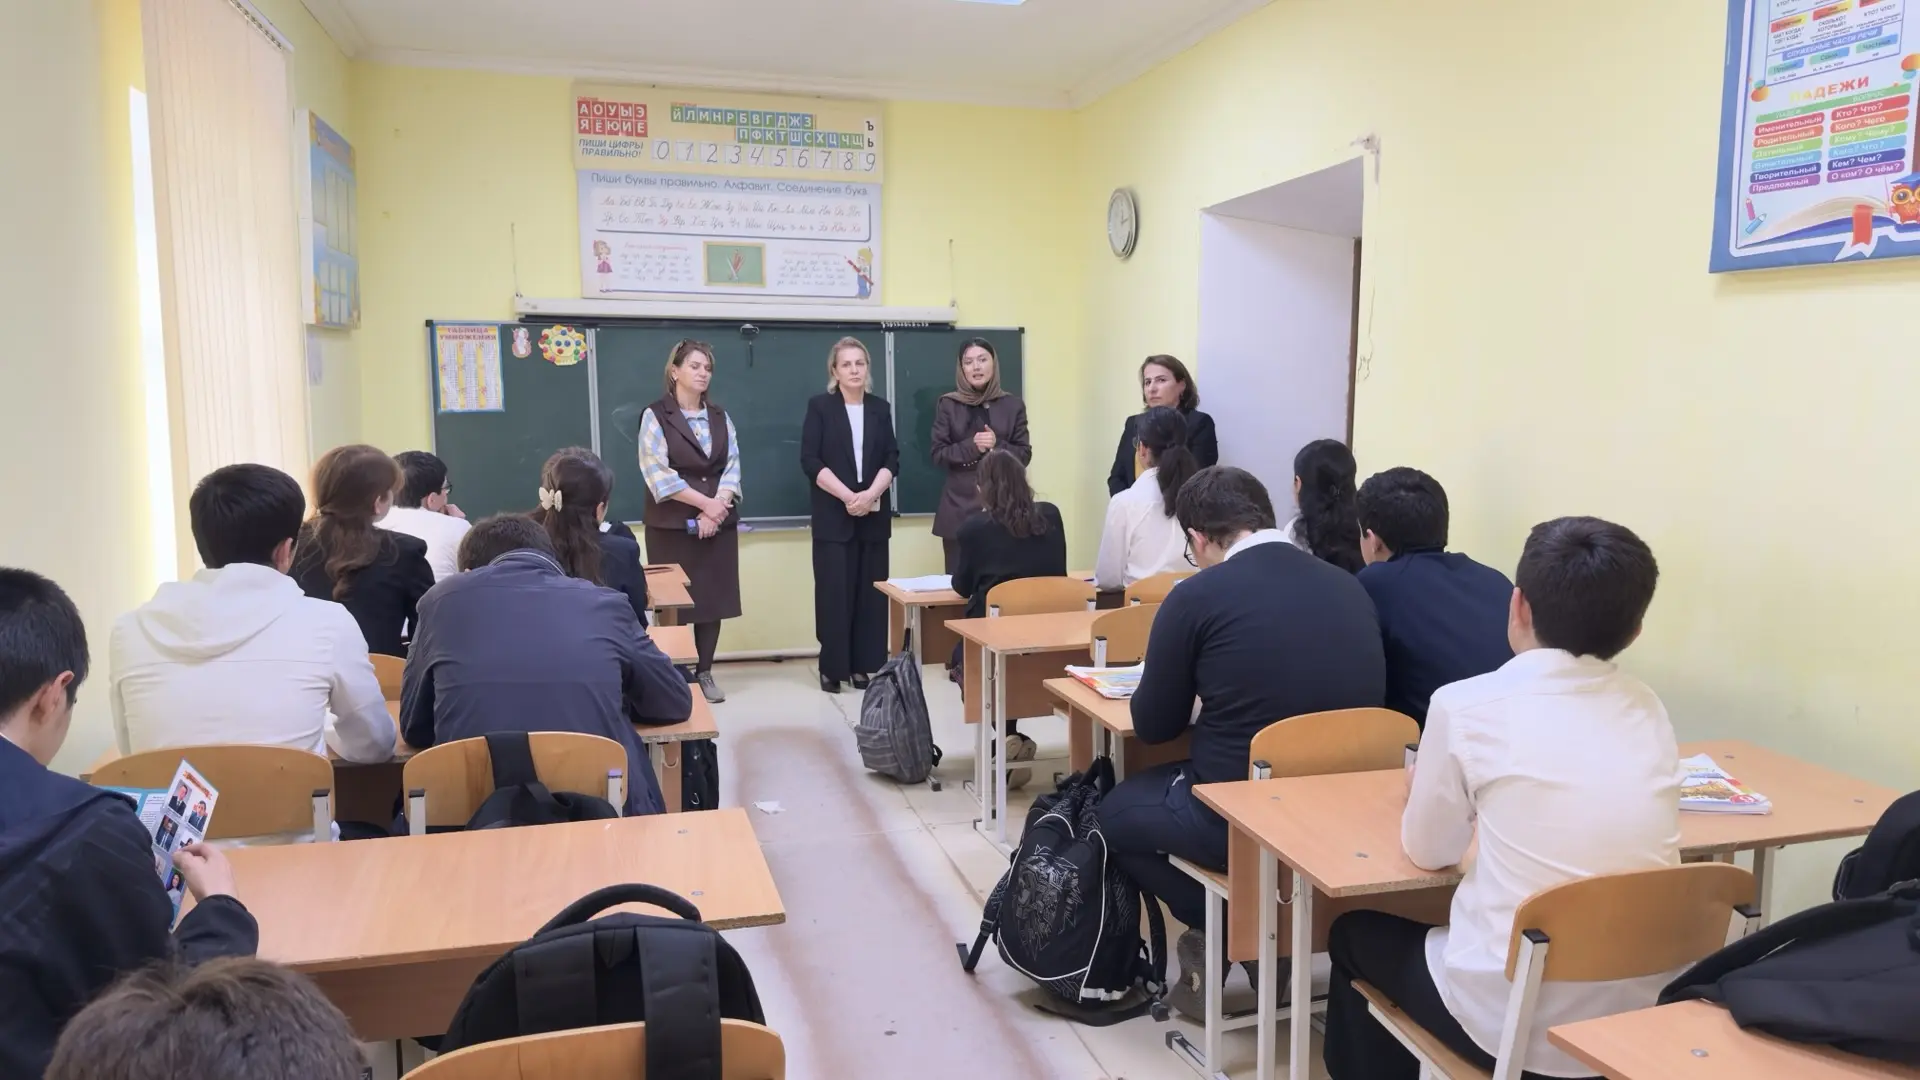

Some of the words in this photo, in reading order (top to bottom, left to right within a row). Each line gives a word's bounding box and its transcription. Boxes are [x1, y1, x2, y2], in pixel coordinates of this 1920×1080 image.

[1789, 76, 1870, 103] ПАДЕЖИ
[1836, 108, 1858, 118] Кто?
[1860, 103, 1884, 113] Что?
[1758, 115, 1822, 134] Именительный
[1835, 119, 1862, 131] Кого?
[578, 138, 607, 148] ПИШИ
[608, 139, 644, 150] ЦИФРЫ
[1757, 129, 1815, 146] Родительный
[581, 148, 642, 159] ПРАВИЛЬНО!
[656, 140, 670, 160] 0
[686, 142, 695, 161] 1
[706, 143, 718, 163] 2
[729, 145, 742, 165] 3
[750, 146, 764, 165] 4
[774, 148, 787, 167] 5
[797, 149, 810, 168] 6
[819, 150, 832, 169] 7
[843, 151, 854, 171] 8
[864, 152, 876, 172] 9
[1832, 157, 1856, 169] Кем?
[1857, 153, 1882, 164] Чем?
[1754, 165, 1817, 181] Творительный
[1831, 172, 1839, 180] О
[1841, 169, 1863, 179] ком?
[1864, 167, 1873, 176] О
[591, 172, 621, 184] Пиши
[625, 174, 658, 186] буквы
[660, 177, 720, 189] правильно.
[724, 179, 773, 192] Алфавит.
[777, 182, 842, 195] Соединение
[1752, 177, 1809, 193] Предложный
